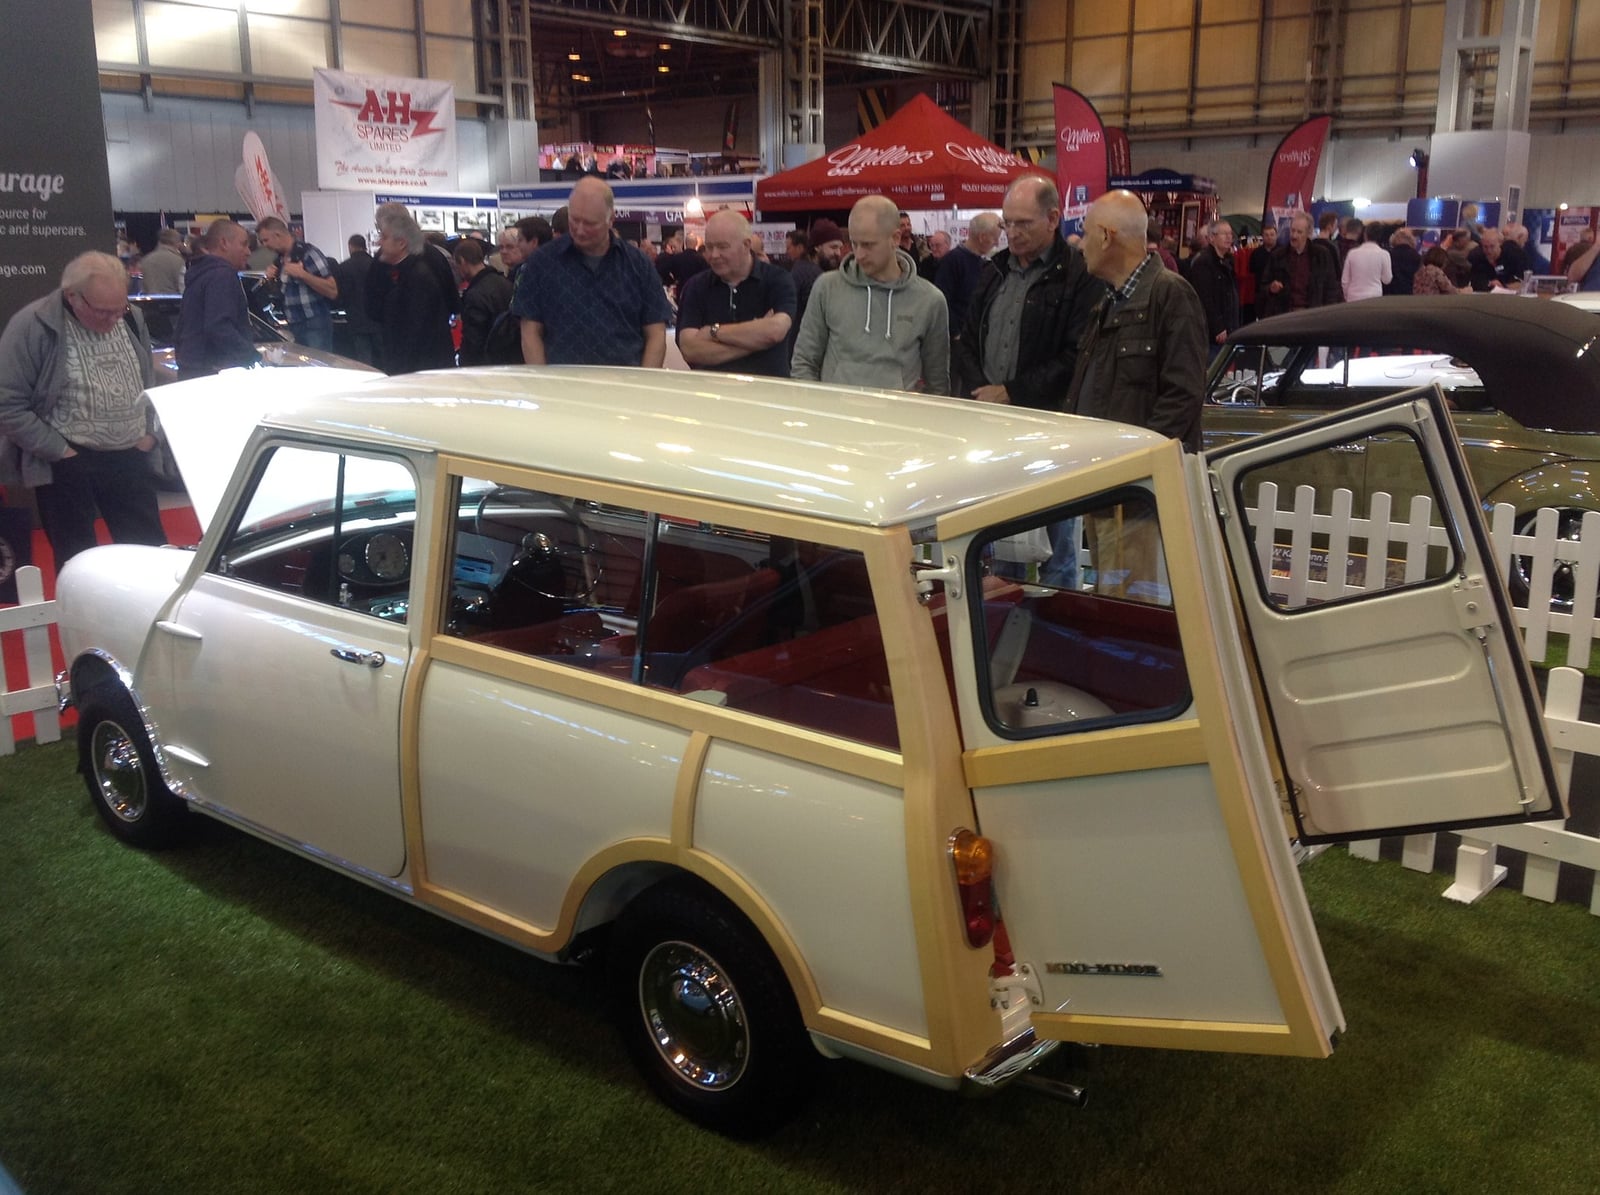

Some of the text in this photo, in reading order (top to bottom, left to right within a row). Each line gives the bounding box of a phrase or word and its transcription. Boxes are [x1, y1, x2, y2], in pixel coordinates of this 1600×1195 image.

[356, 124, 409, 142] SPARES
[1061, 126, 1100, 145] Millers
[369, 142, 402, 153] LIMITED
[827, 144, 934, 168] Millers
[335, 160, 349, 176] The
[32, 207, 48, 219] for
[8, 223, 30, 236] and
[32, 226, 87, 238] supercars.
